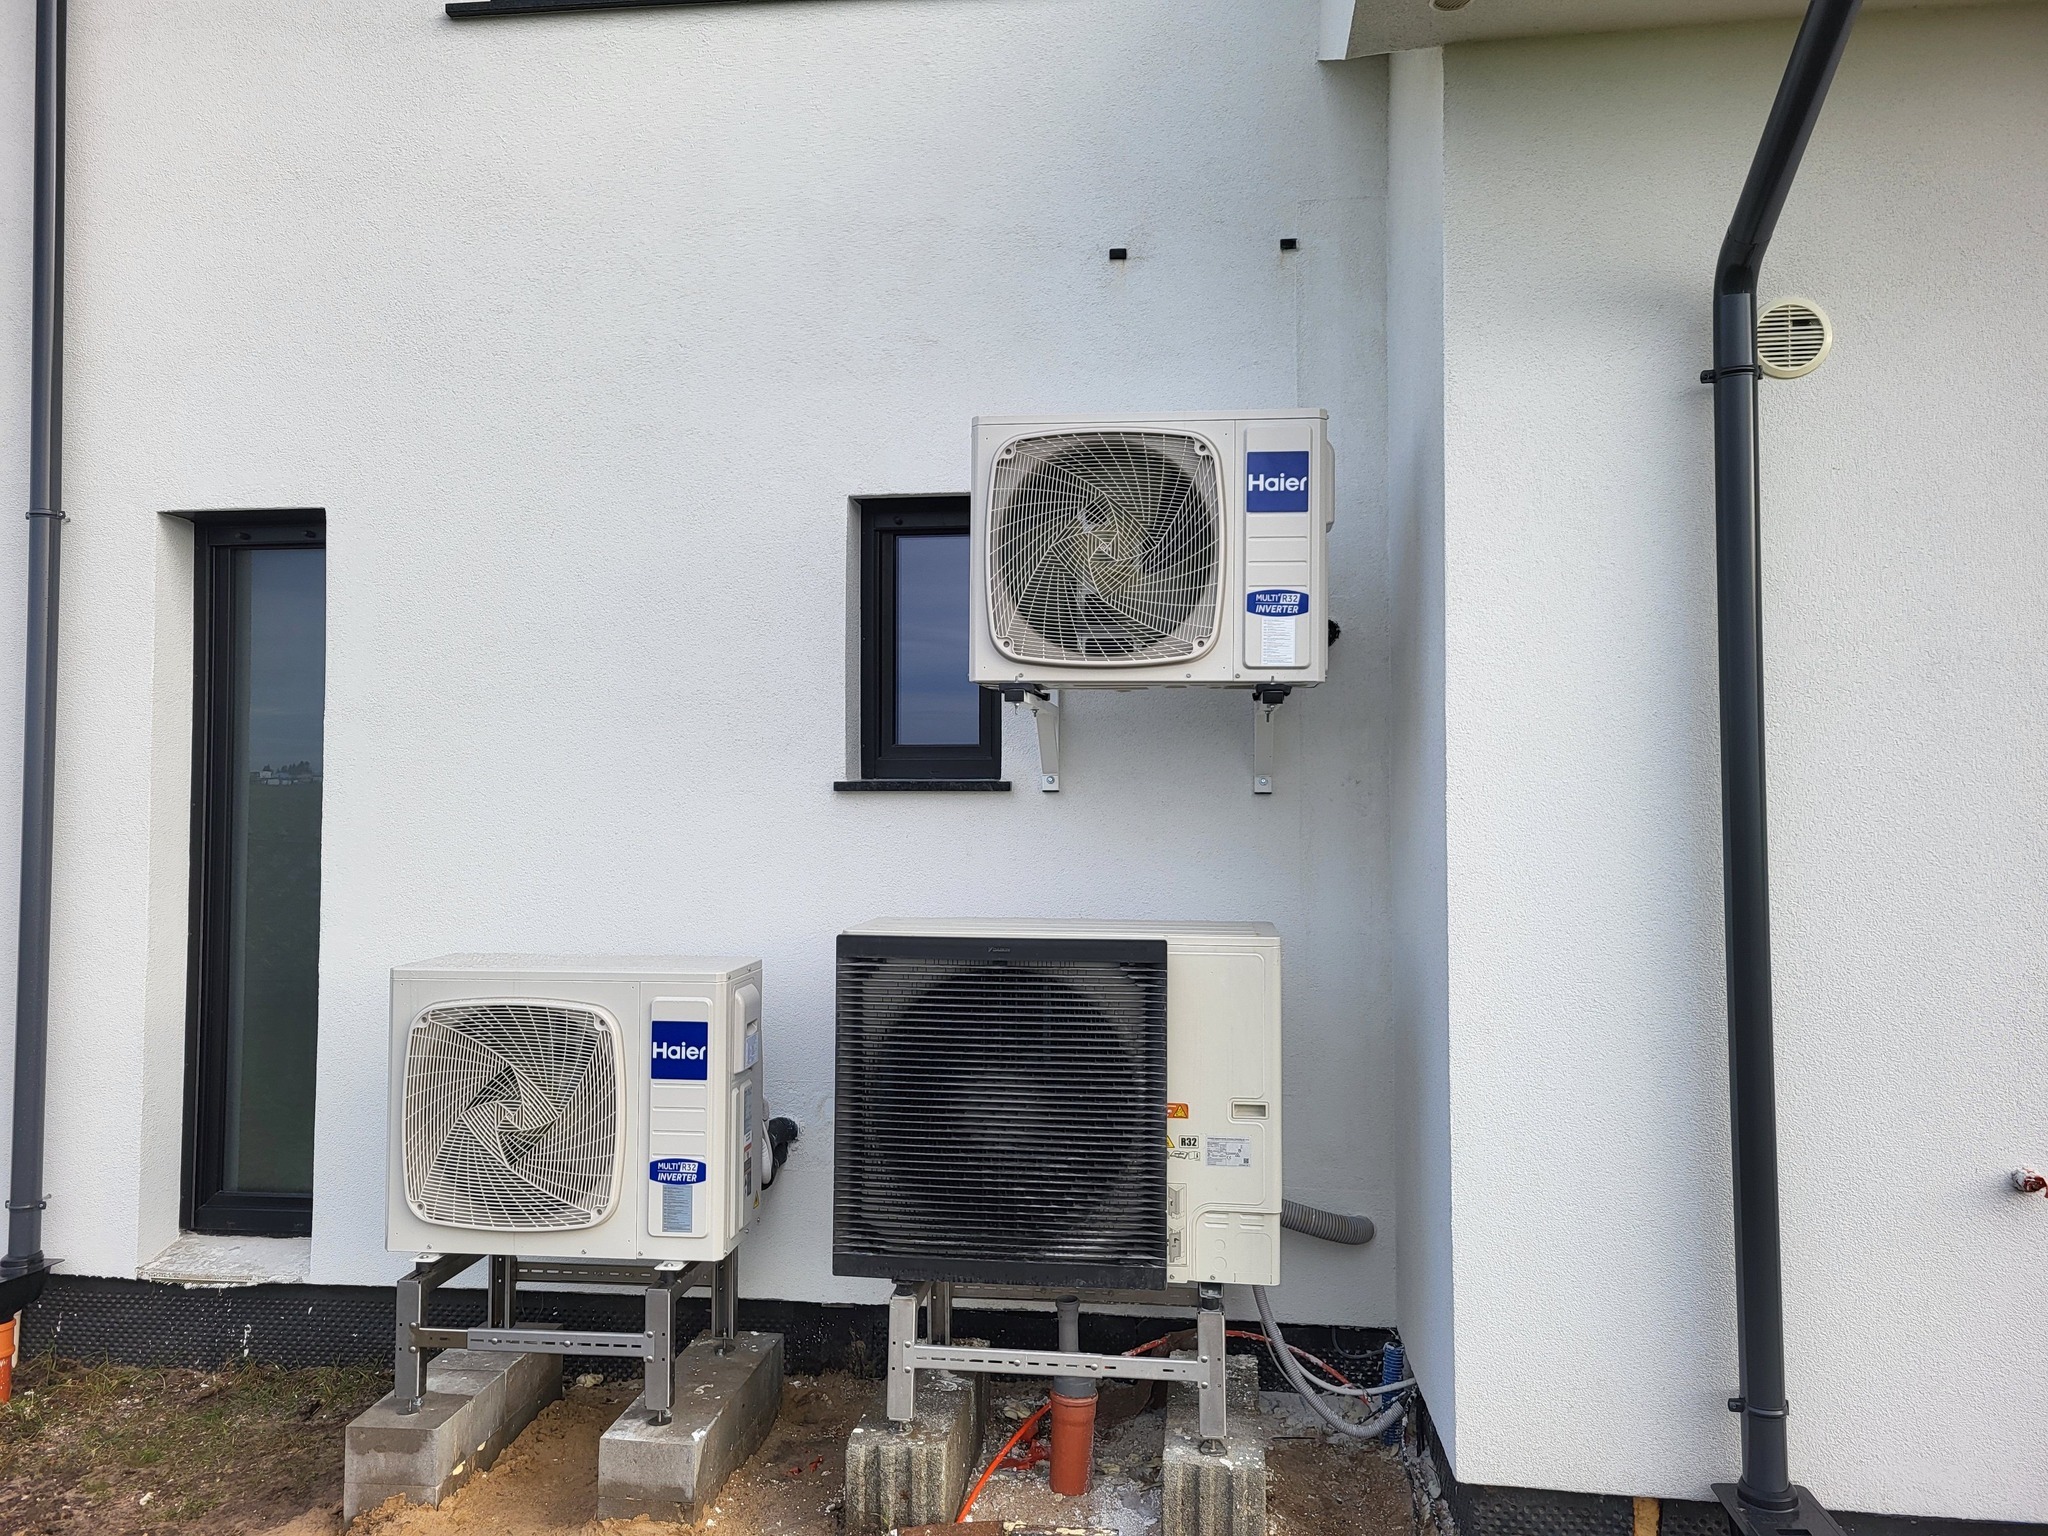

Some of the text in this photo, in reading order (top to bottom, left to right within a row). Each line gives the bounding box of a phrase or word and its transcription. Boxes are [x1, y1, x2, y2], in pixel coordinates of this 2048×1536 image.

[1248, 473, 1307, 492] Haier
[1282, 594, 1298, 603] R32
[1255, 604, 1299, 614] INVERTER
[652, 1041, 706, 1060] Haier
[1181, 1137, 1197, 1147] R32
[681, 1163, 697, 1172] R32
[657, 1172, 697, 1182] INVERTER
